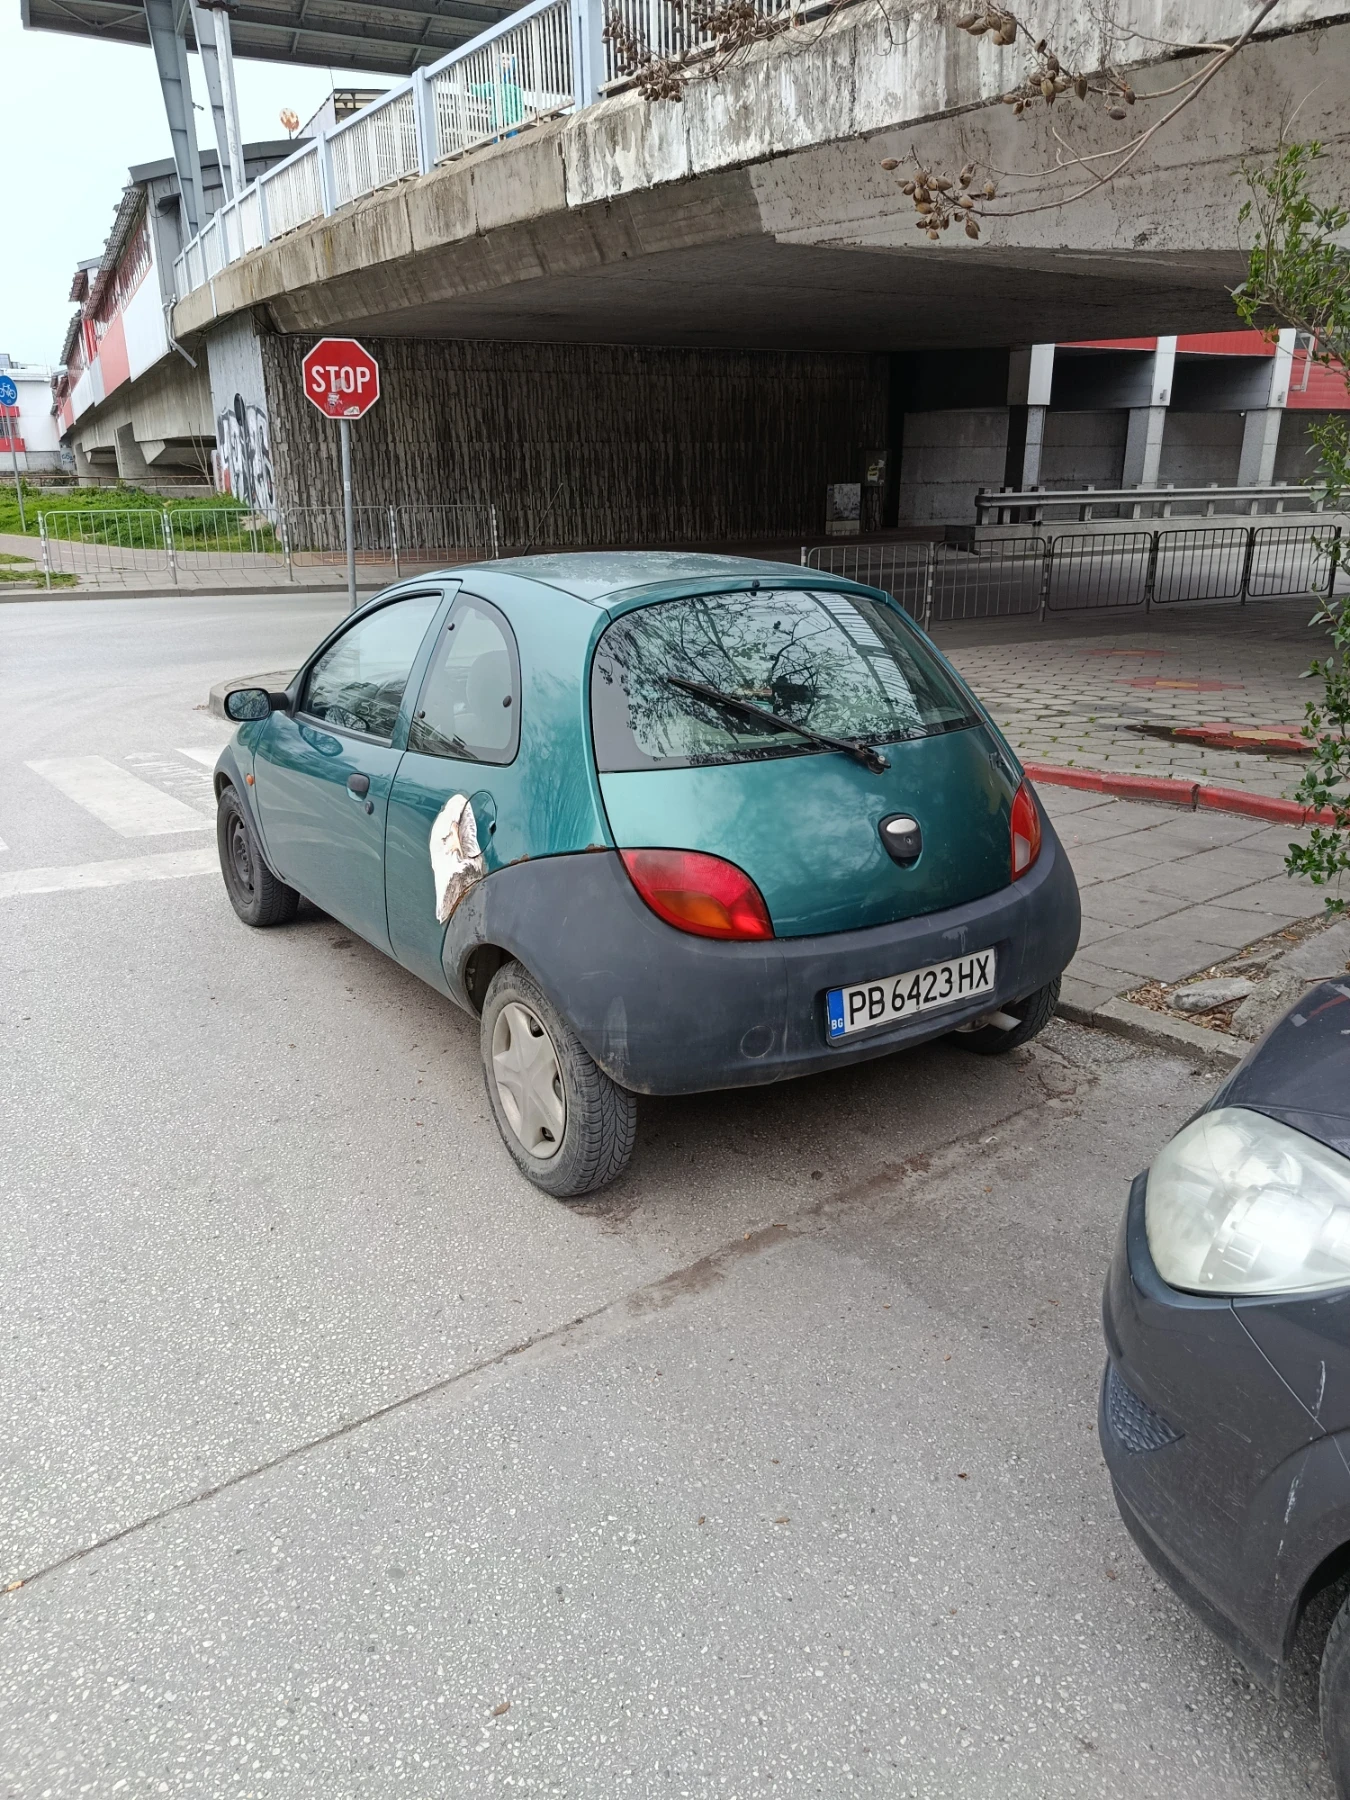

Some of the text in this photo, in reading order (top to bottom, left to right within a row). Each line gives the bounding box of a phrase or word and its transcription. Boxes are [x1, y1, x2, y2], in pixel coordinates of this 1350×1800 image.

[311, 365, 371, 393] STOP
[848, 954, 990, 1025] PB 6423 HX
[831, 1018, 844, 1030] BG
